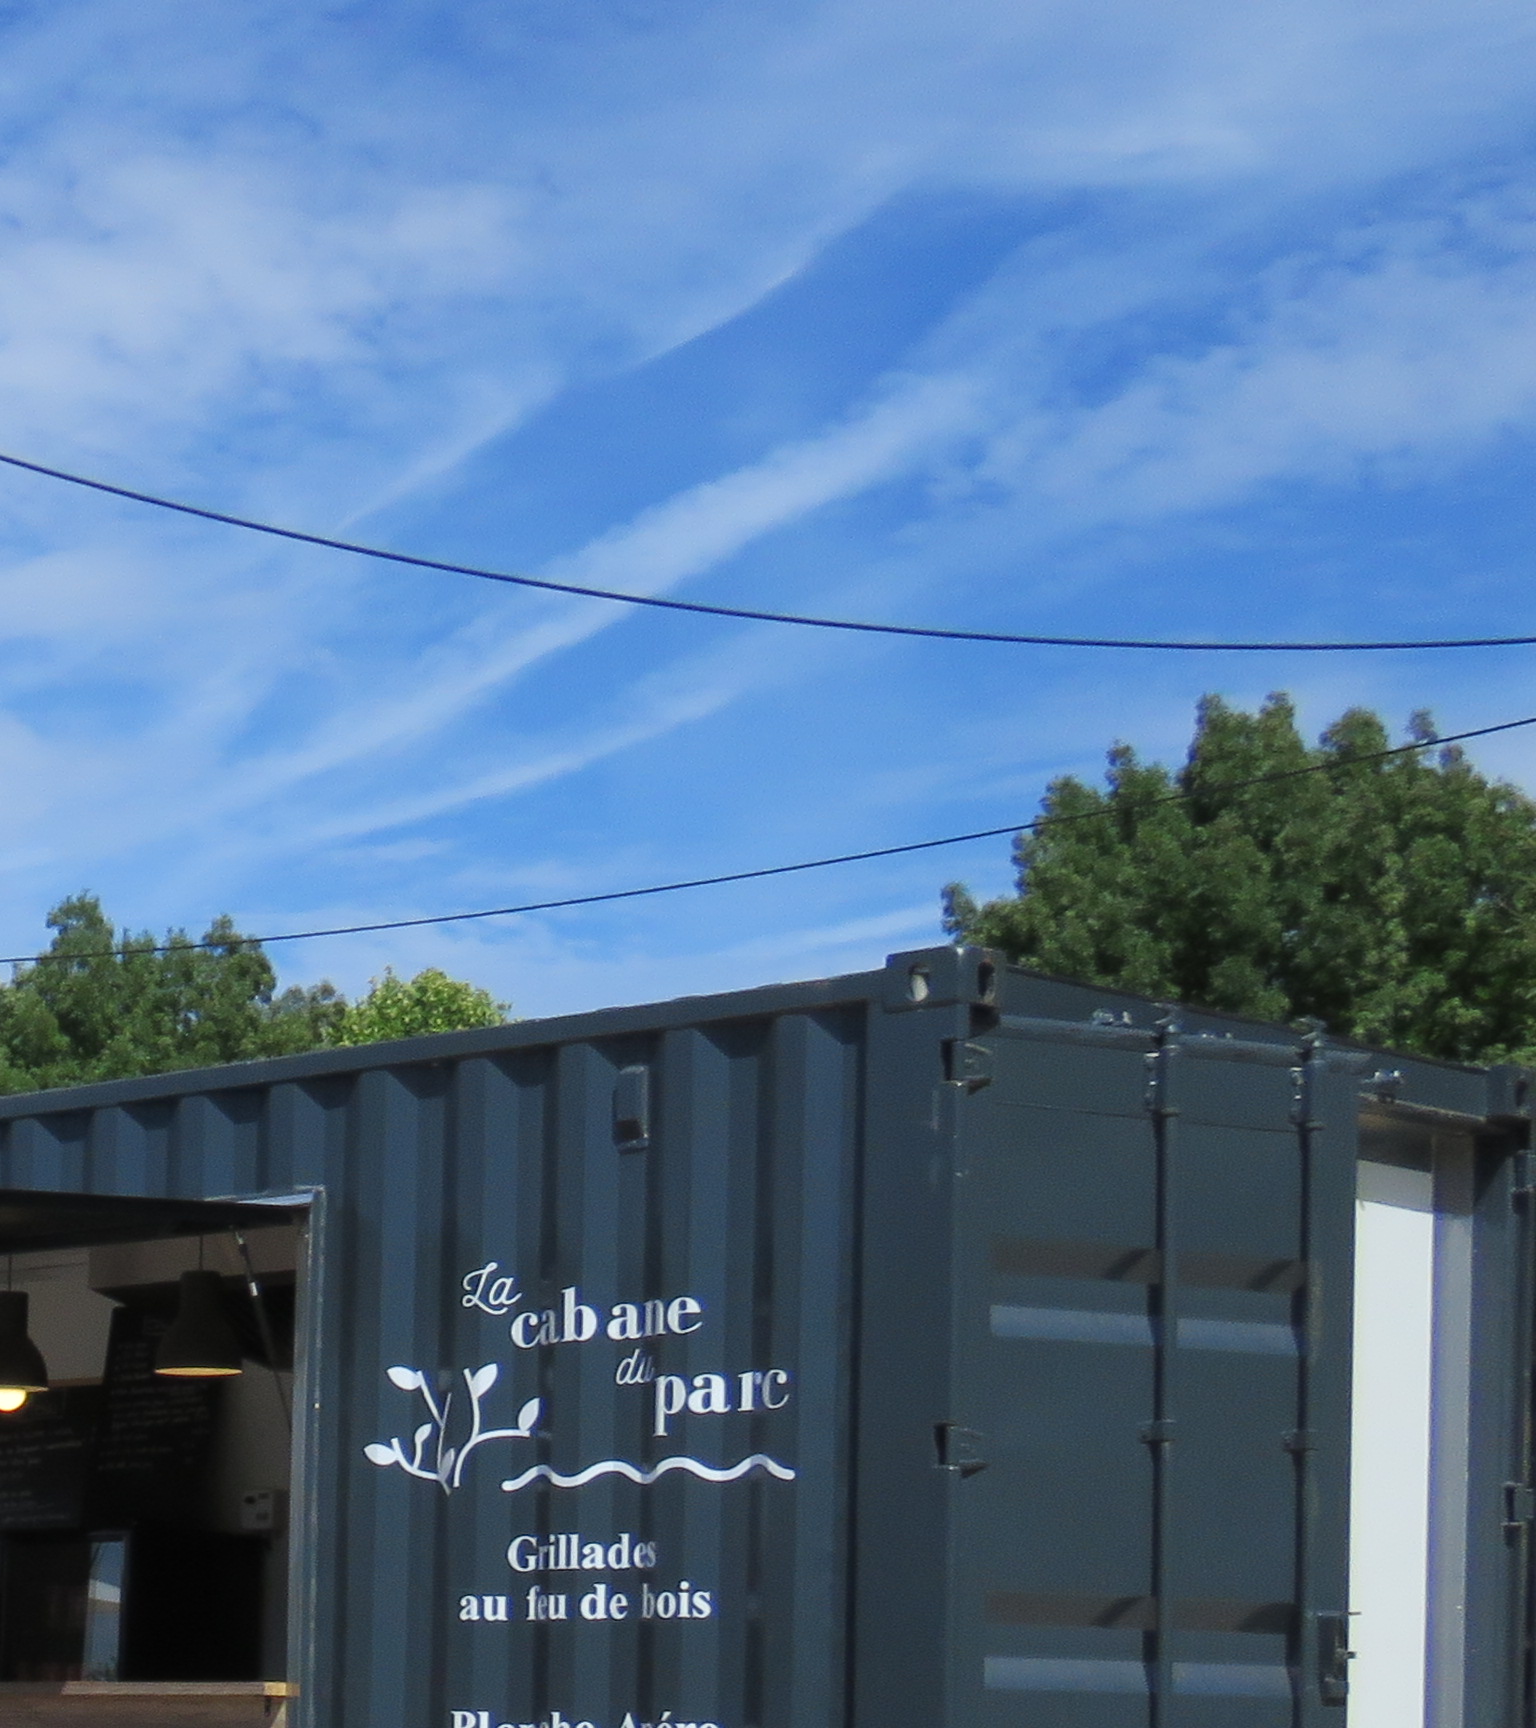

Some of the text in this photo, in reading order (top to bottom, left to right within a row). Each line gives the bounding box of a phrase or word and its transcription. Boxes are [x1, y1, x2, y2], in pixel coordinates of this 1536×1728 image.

[461, 1261, 522, 1315] La
[509, 1286, 703, 1349] cabane
[615, 1349, 657, 1385] du
[652, 1367, 790, 1438] parc
[506, 1533, 658, 1572] Grillades
[458, 1581, 713, 1621] au feu de bois
